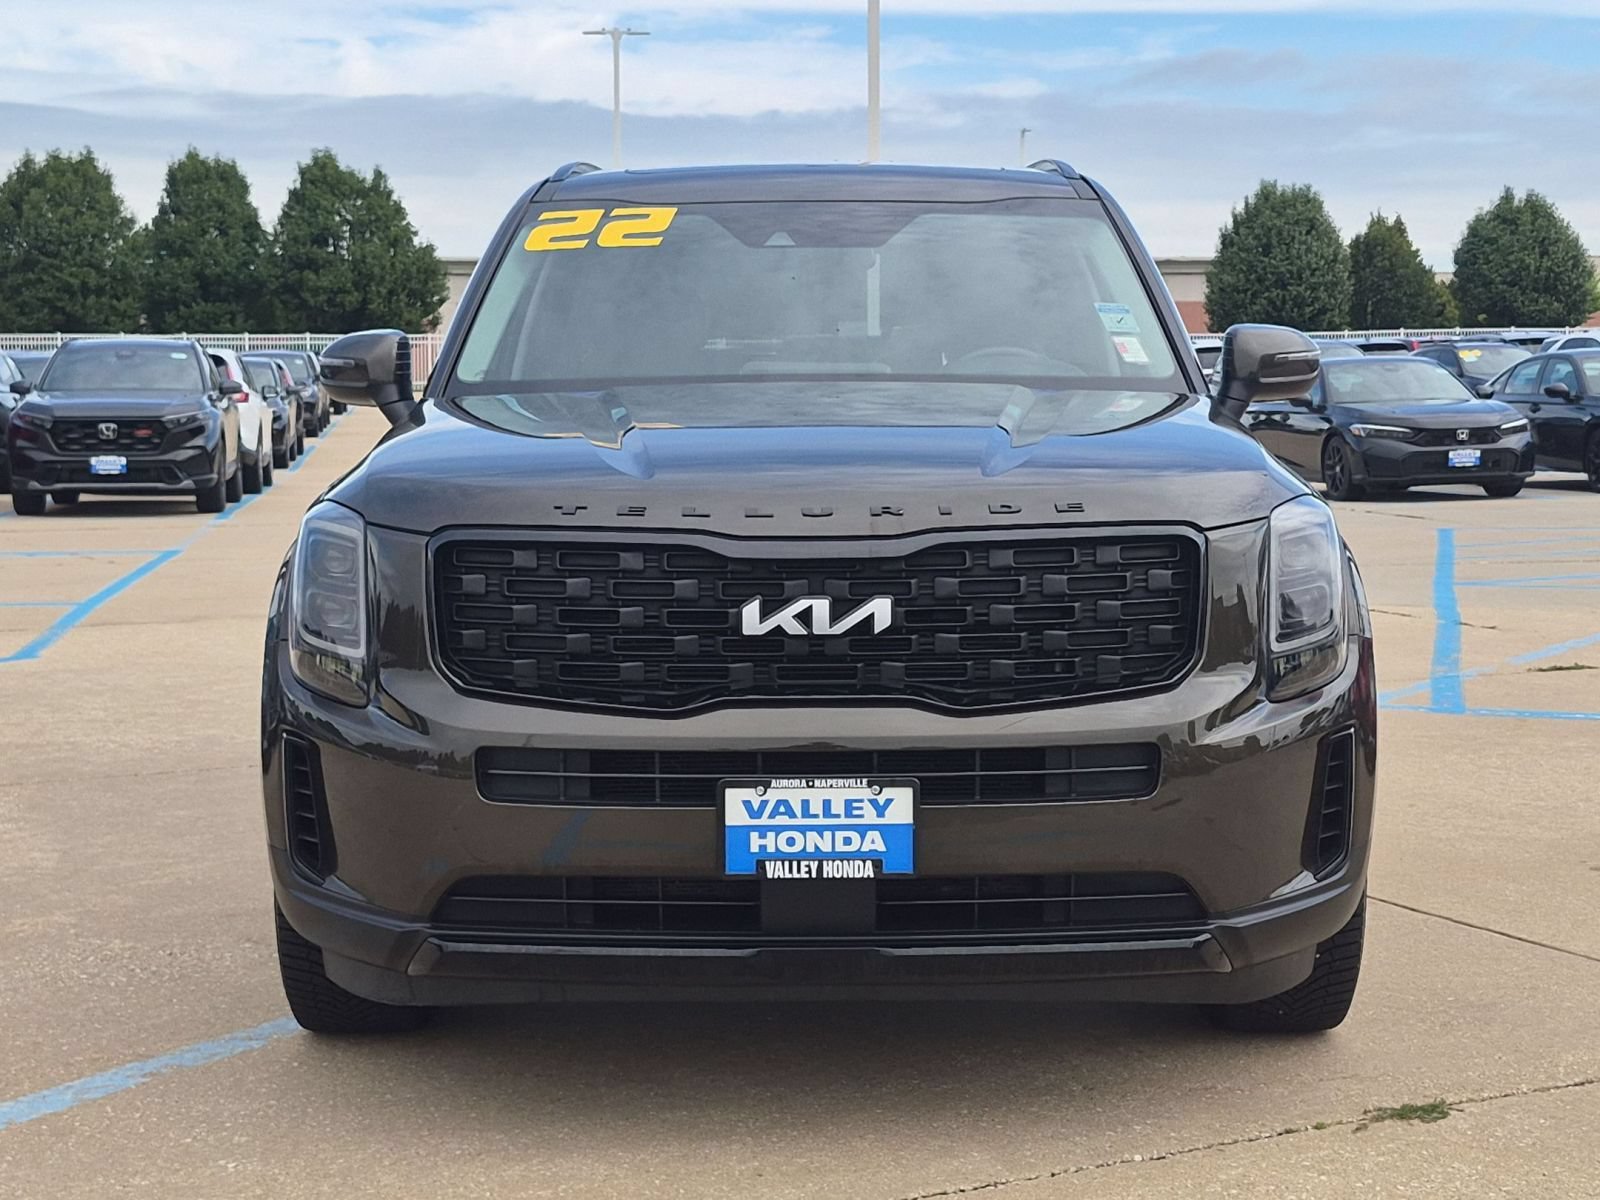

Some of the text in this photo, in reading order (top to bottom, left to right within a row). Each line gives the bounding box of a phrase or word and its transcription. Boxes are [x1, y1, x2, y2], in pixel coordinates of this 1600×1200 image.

[524, 207, 678, 251] 22
[553, 502, 1085, 518] TELLURIDE
[741, 596, 893, 636] KIA
[770, 778, 868, 788] AURORA NAPERVILLE
[741, 798, 895, 820] VALLEY
[750, 830, 887, 853] HONDA
[765, 860, 875, 879] VALLEY HONDA
